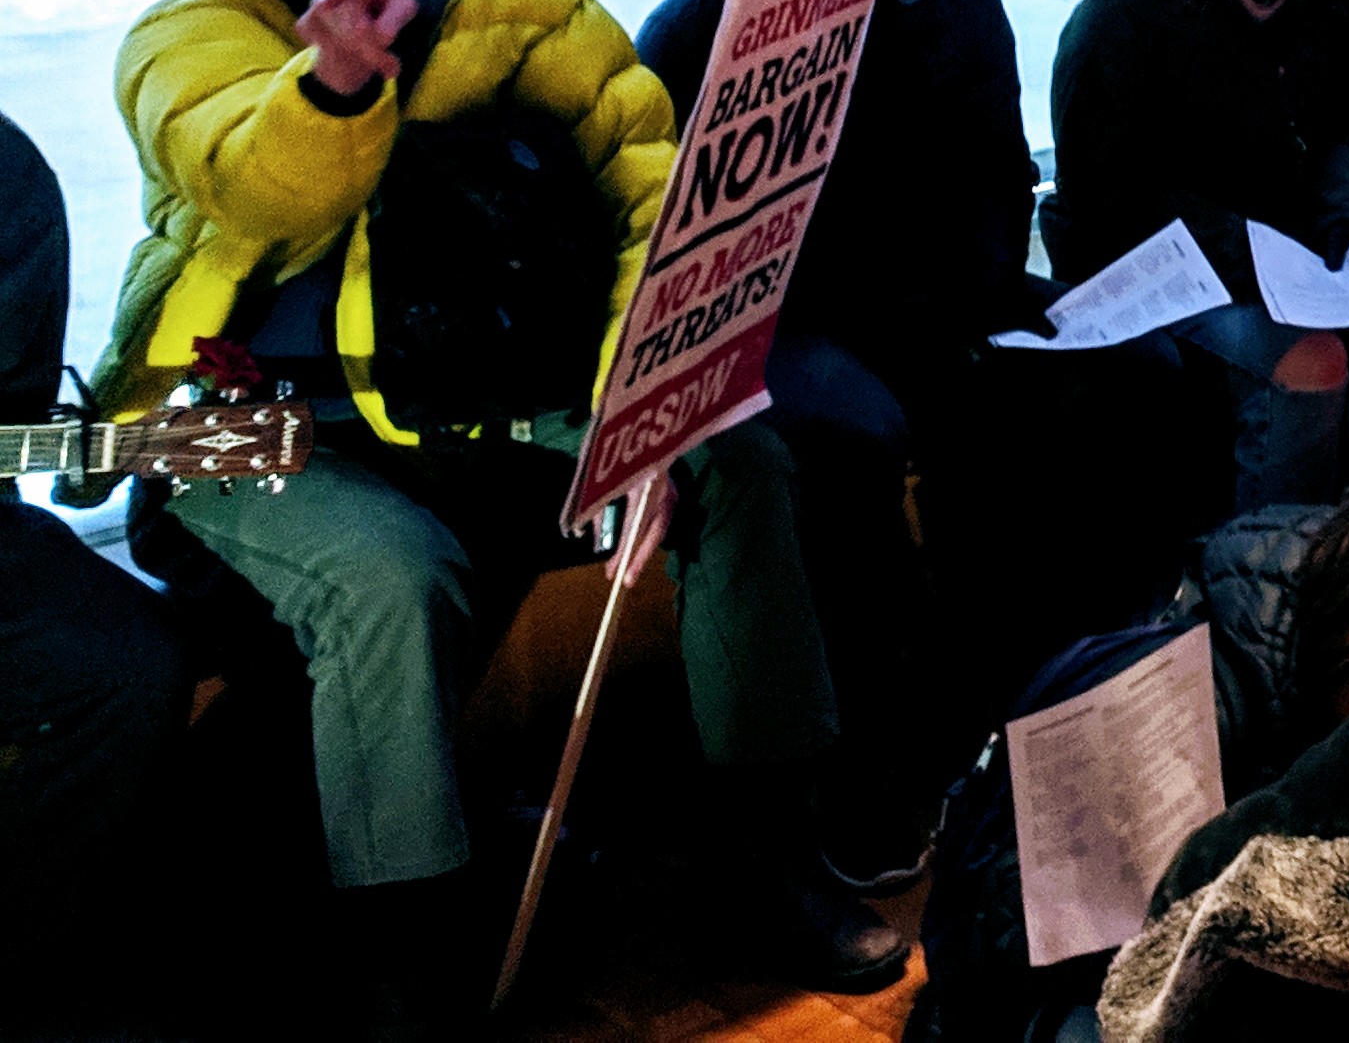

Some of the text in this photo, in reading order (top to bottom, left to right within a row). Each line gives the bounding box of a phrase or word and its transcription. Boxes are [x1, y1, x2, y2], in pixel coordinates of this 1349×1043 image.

[705, 15, 865, 133] BARGAIN
[677, 70, 847, 233] NOW!
[625, 250, 791, 388] THREATS!
[644, 201, 806, 332] NO MORE
[595, 349, 741, 483] UGSDW
